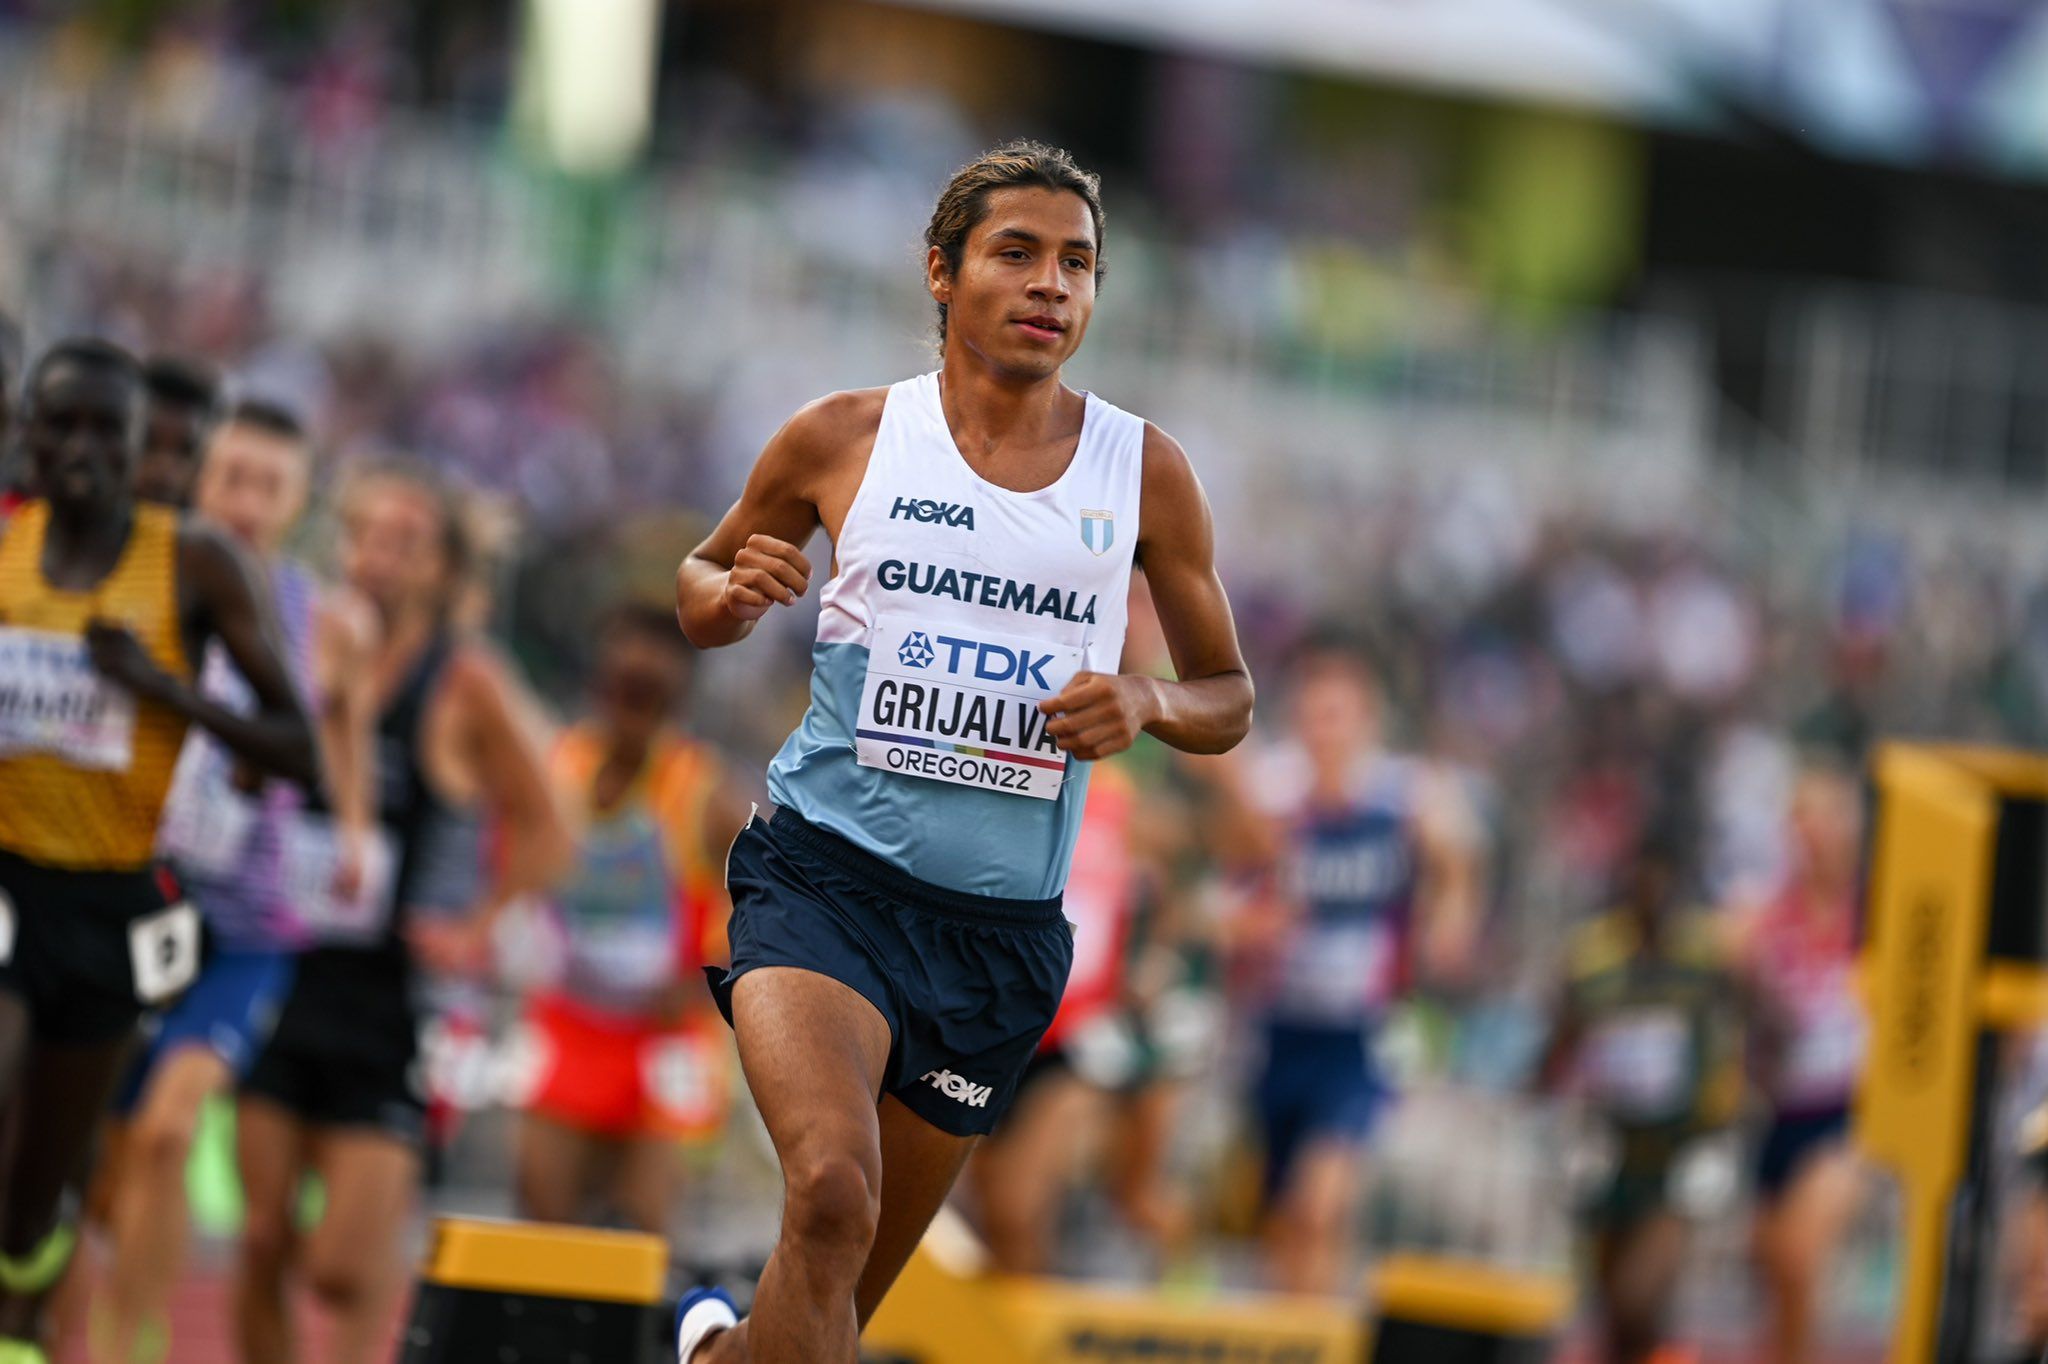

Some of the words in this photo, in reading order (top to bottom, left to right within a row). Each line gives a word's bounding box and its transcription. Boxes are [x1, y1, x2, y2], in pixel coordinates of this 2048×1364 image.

[889, 497, 975, 531] HOKA
[877, 559, 1097, 624] GUATEMALA
[937, 635, 1055, 690] TDK
[886, 748, 1031, 790] OREGON22
[920, 1069, 993, 1107] HOKA
